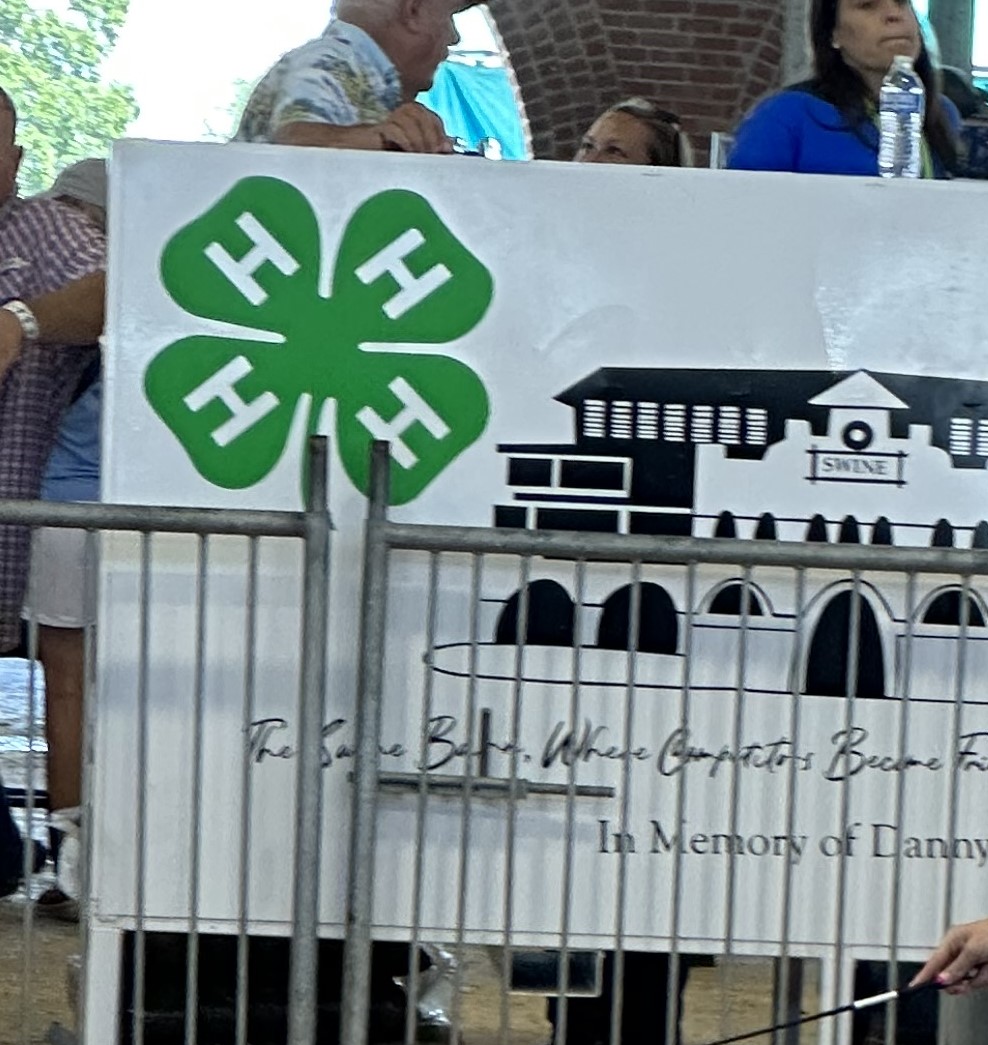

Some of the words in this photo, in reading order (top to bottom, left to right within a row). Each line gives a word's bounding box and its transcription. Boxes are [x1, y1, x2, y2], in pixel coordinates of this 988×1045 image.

[203, 211, 301, 306] H
[354, 228, 453, 320] H
[182, 355, 280, 447] H
[355, 376, 452, 470] H
[821, 457, 888, 475] SWINE
[248, 718, 294, 763] The
[824, 727, 942, 781] Become
[598, 819, 637, 854] In
[650, 819, 807, 865] Memory
[819, 821, 862, 857] of
